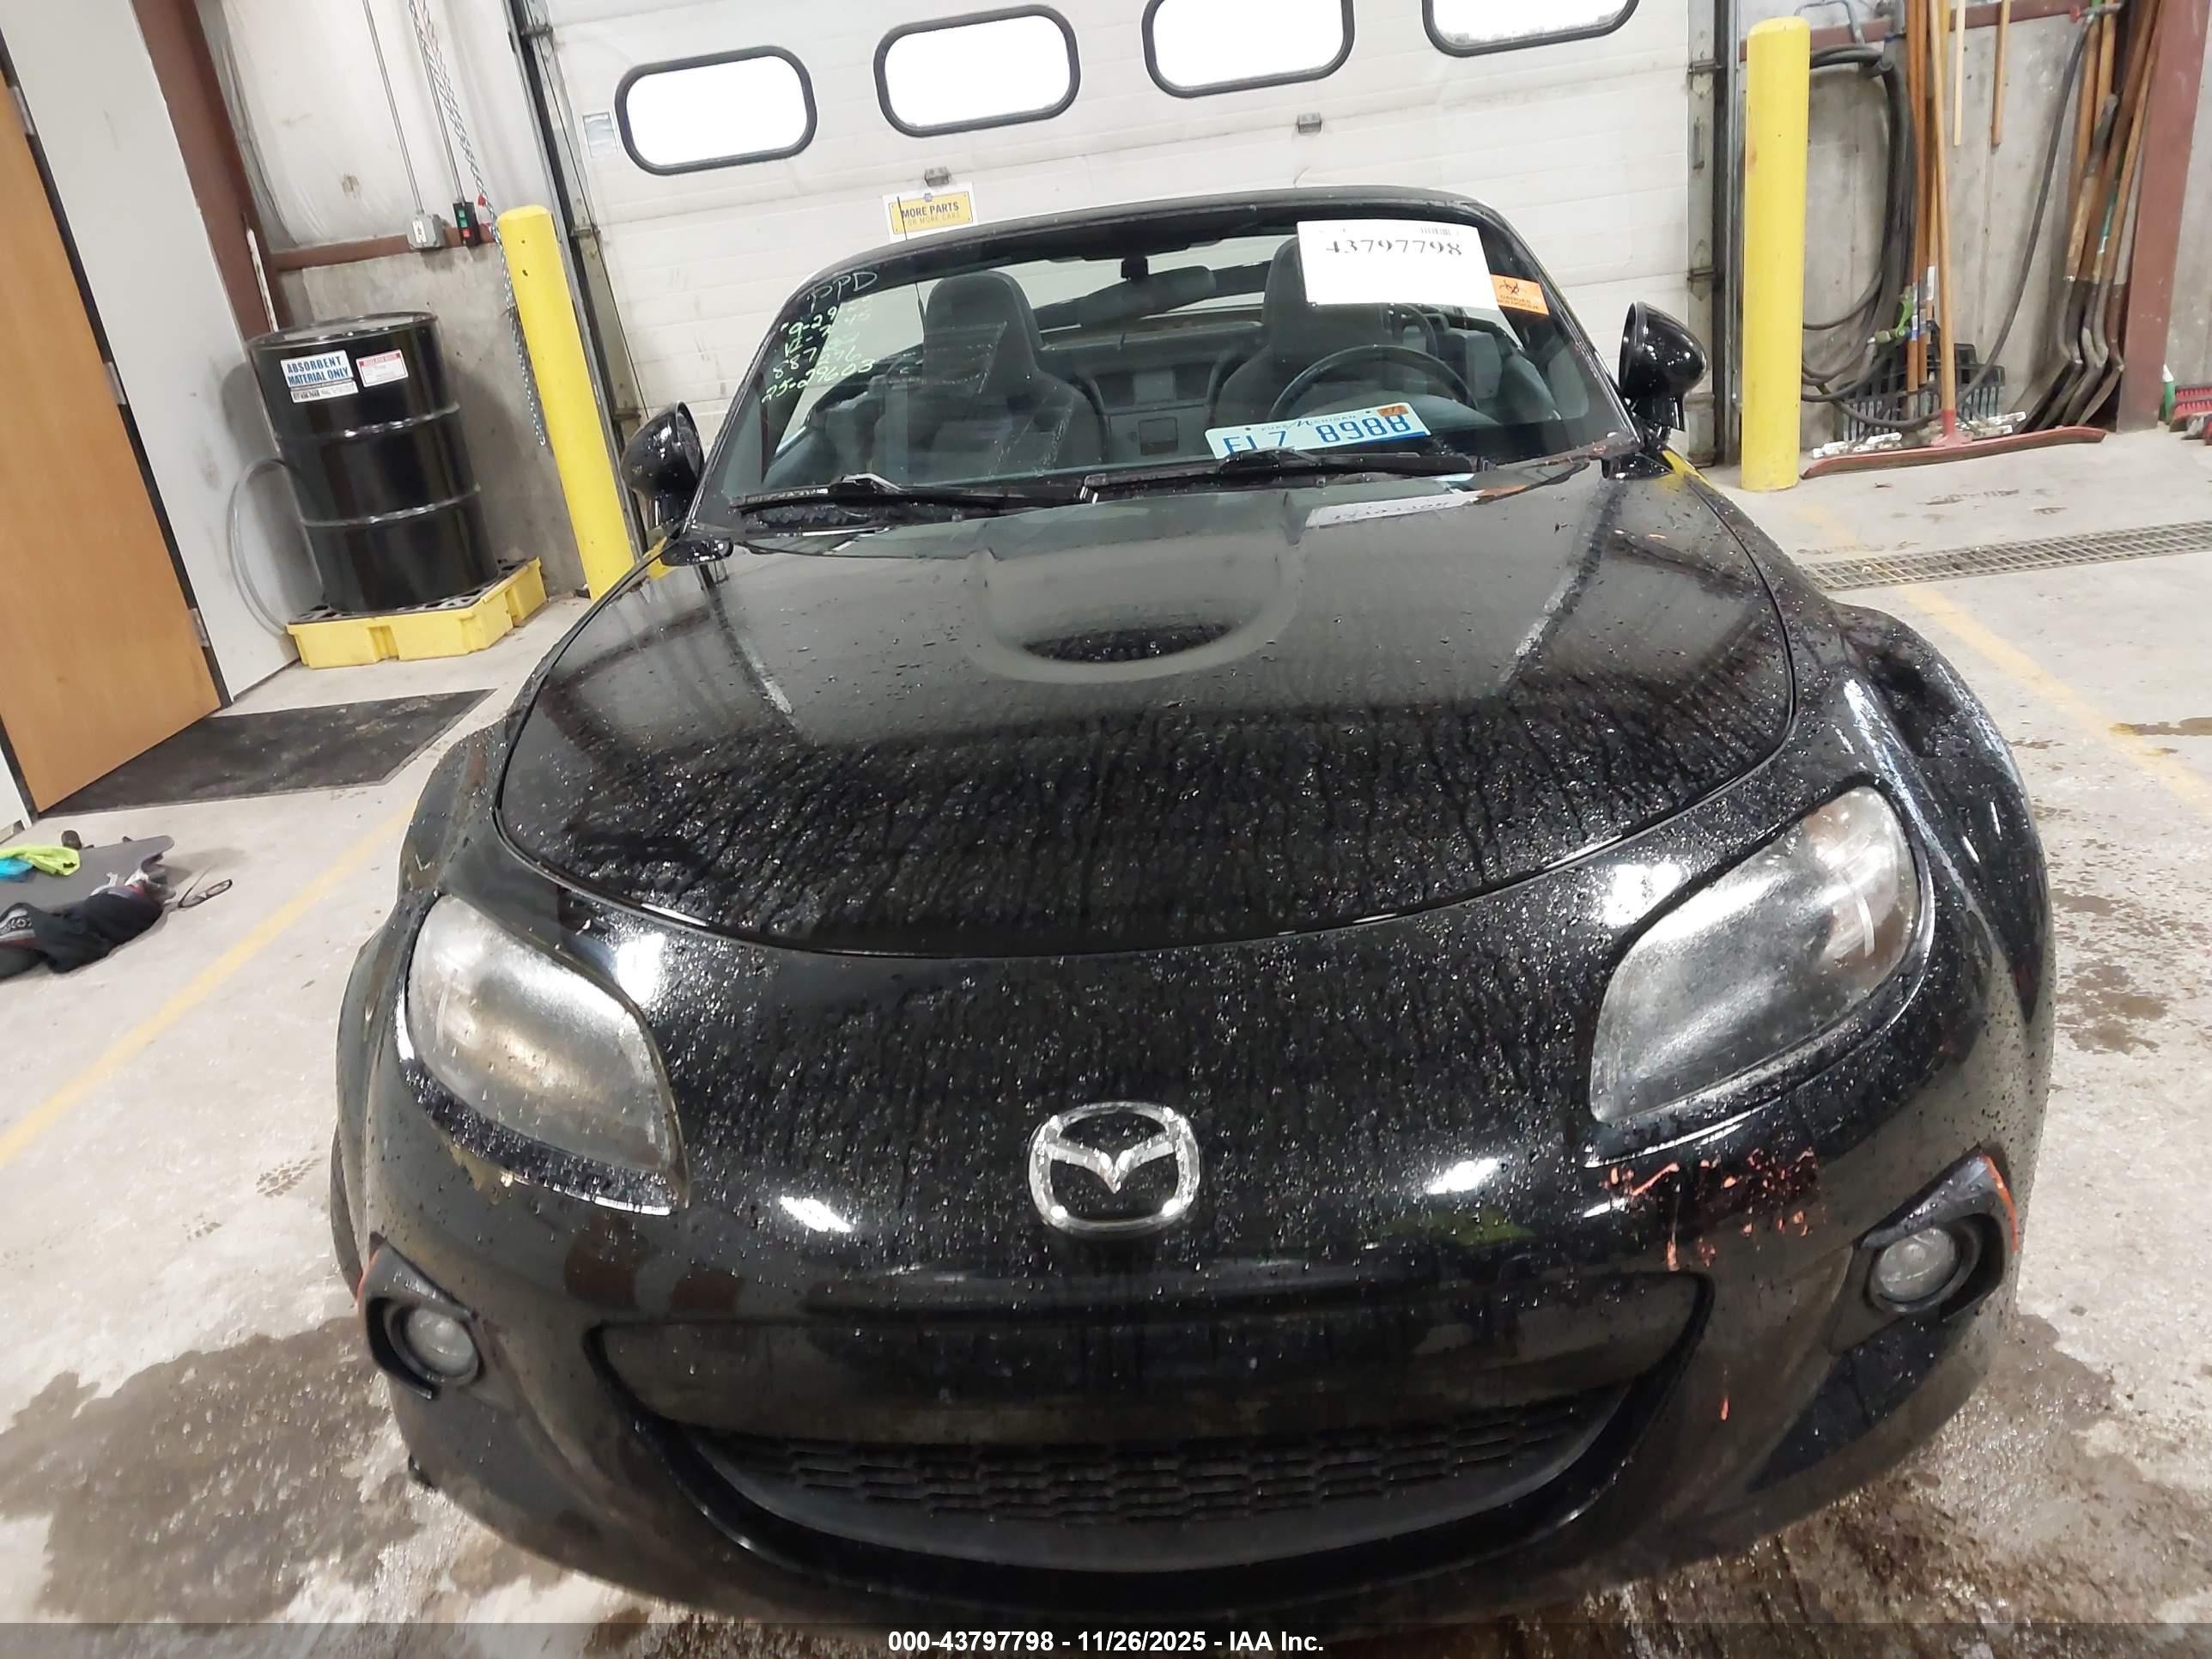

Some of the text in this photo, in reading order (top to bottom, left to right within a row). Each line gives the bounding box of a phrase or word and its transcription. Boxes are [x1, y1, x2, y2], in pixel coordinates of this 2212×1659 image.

[902, 202, 959, 219] MORE PARTS
[1326, 239, 1462, 256] 43797798
[287, 356, 342, 374] ABSORBENT
[288, 371, 327, 386] MATERIAL
[327, 367, 349, 380] ONLY
[1316, 414, 1411, 443] 8988
